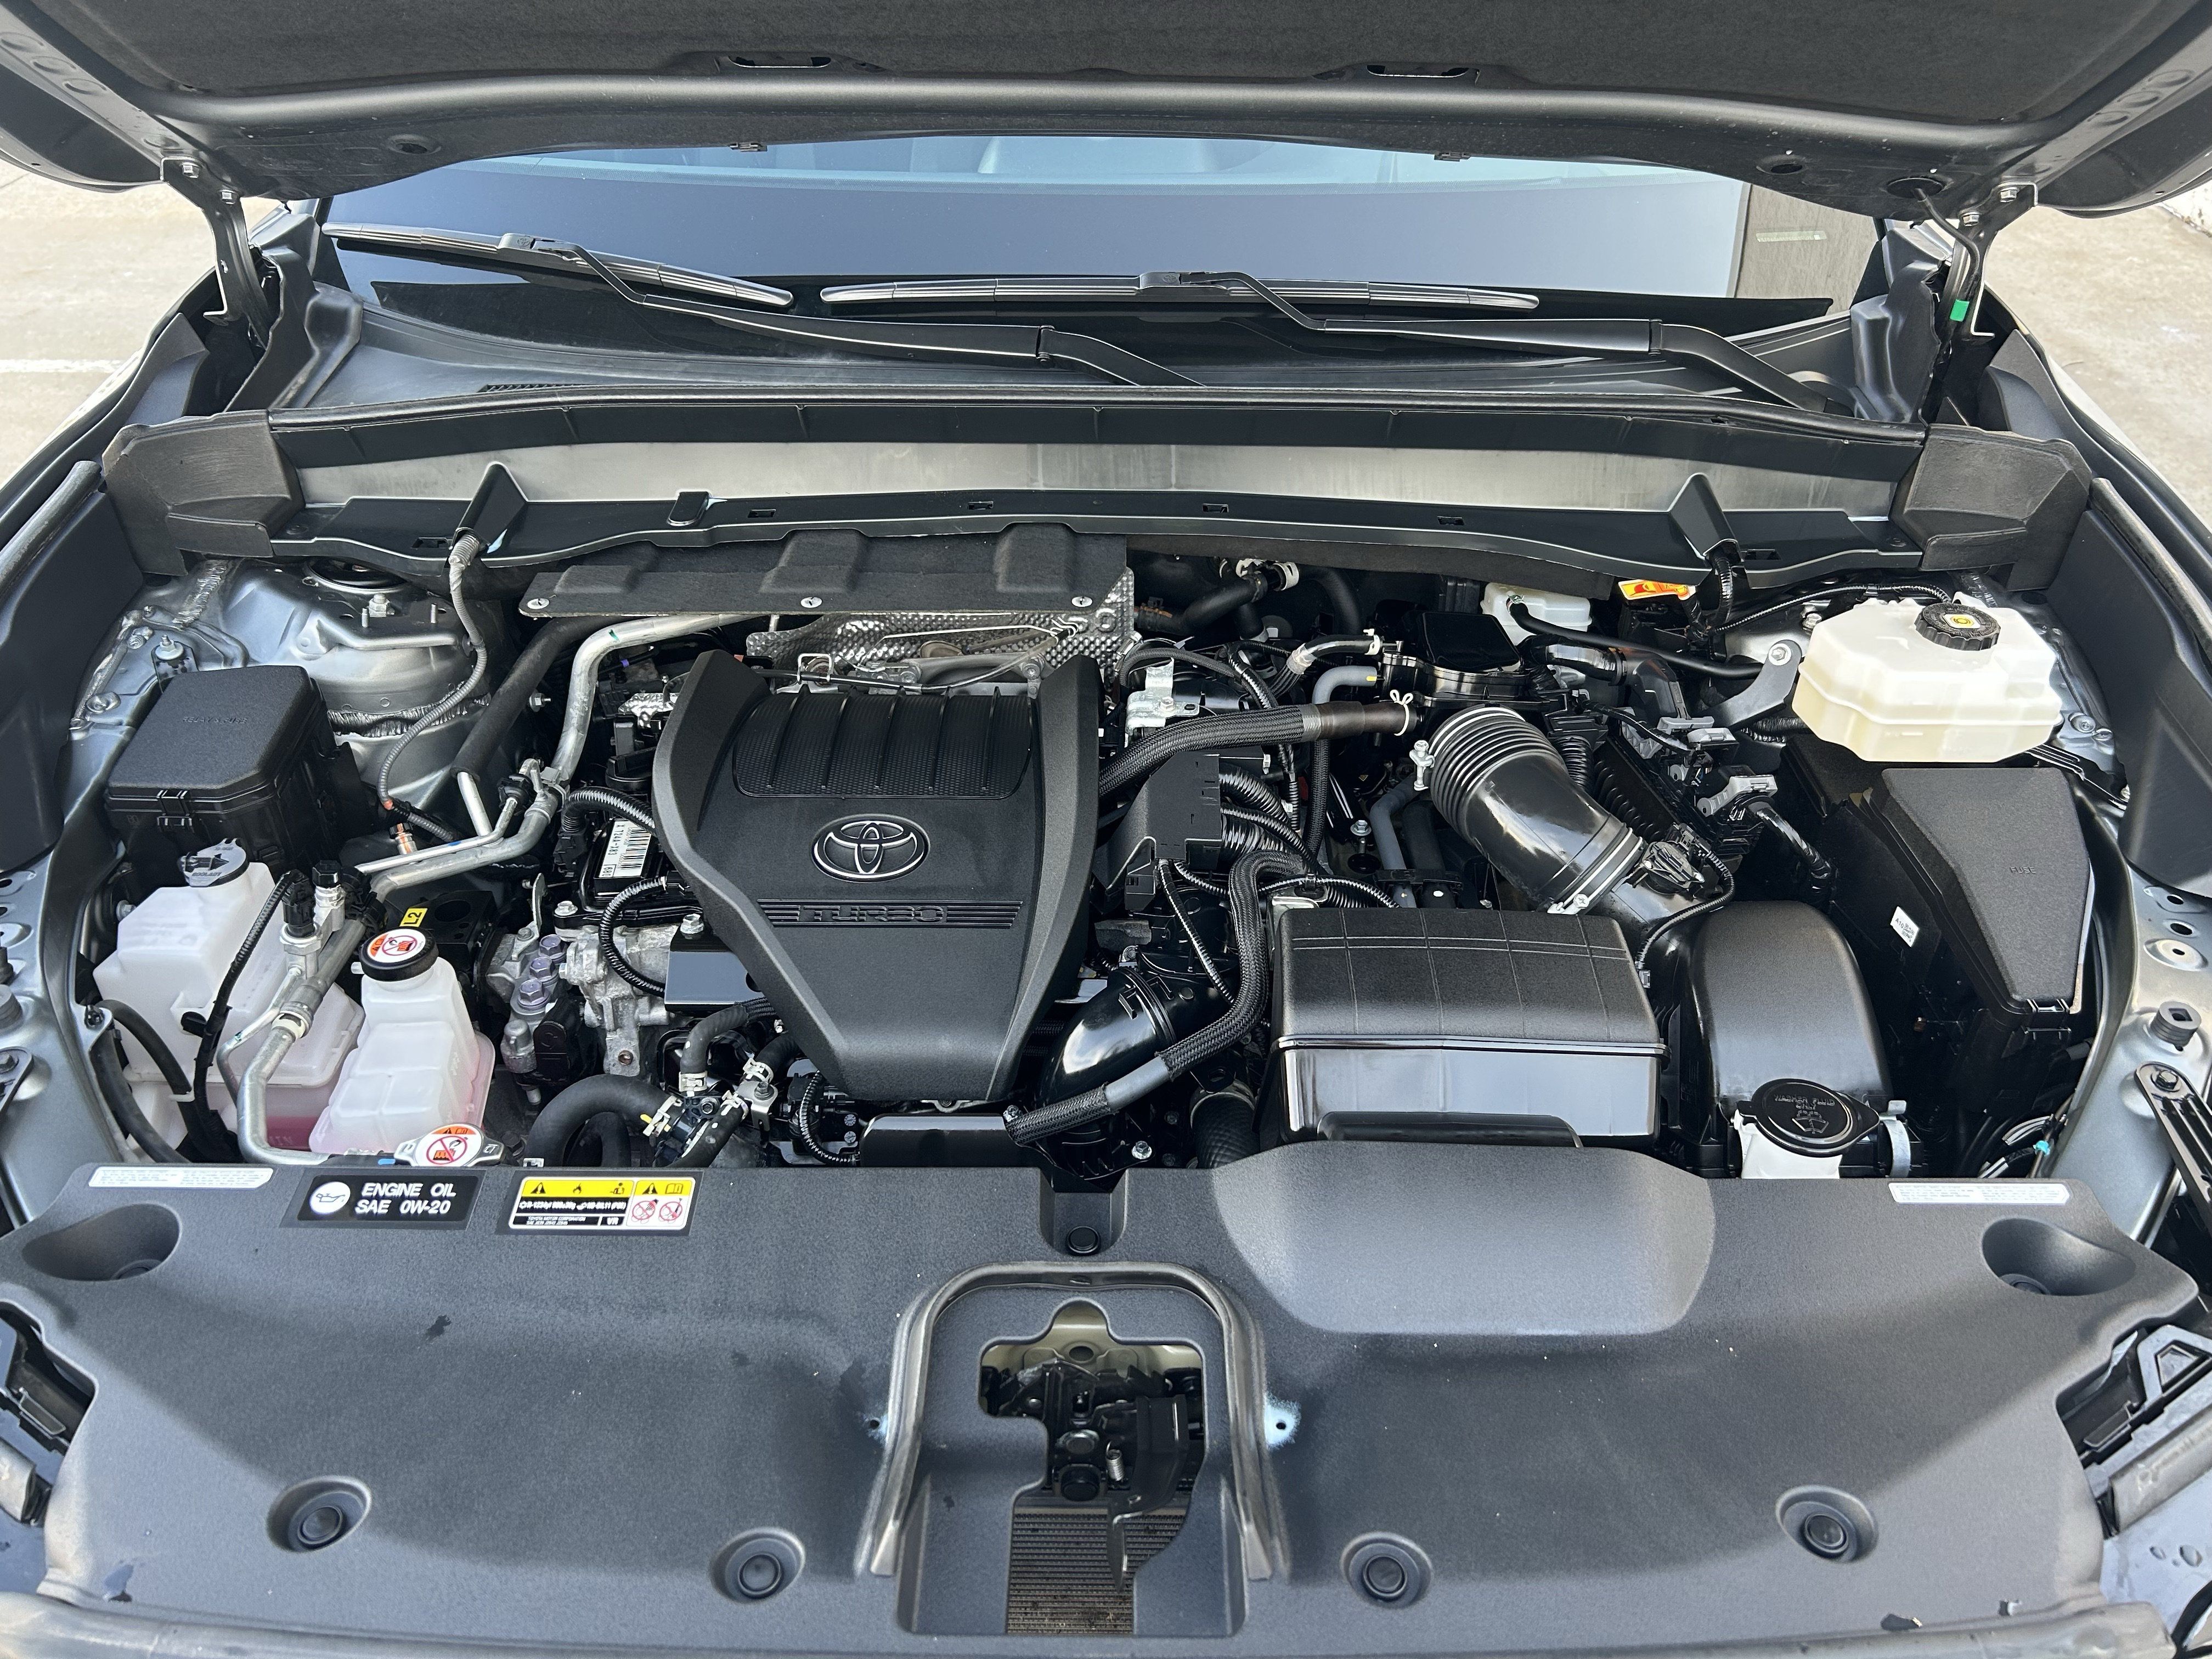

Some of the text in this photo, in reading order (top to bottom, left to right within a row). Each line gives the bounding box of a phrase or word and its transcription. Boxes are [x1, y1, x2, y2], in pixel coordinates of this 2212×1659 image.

[403, 911, 422, 925] L2
[803, 905, 944, 922] TURBO
[1812, 1097, 1835, 1106] FLUID
[362, 1182, 456, 1197] ENGINE OIL
[355, 1199, 452, 1215] SAE 0W-20
